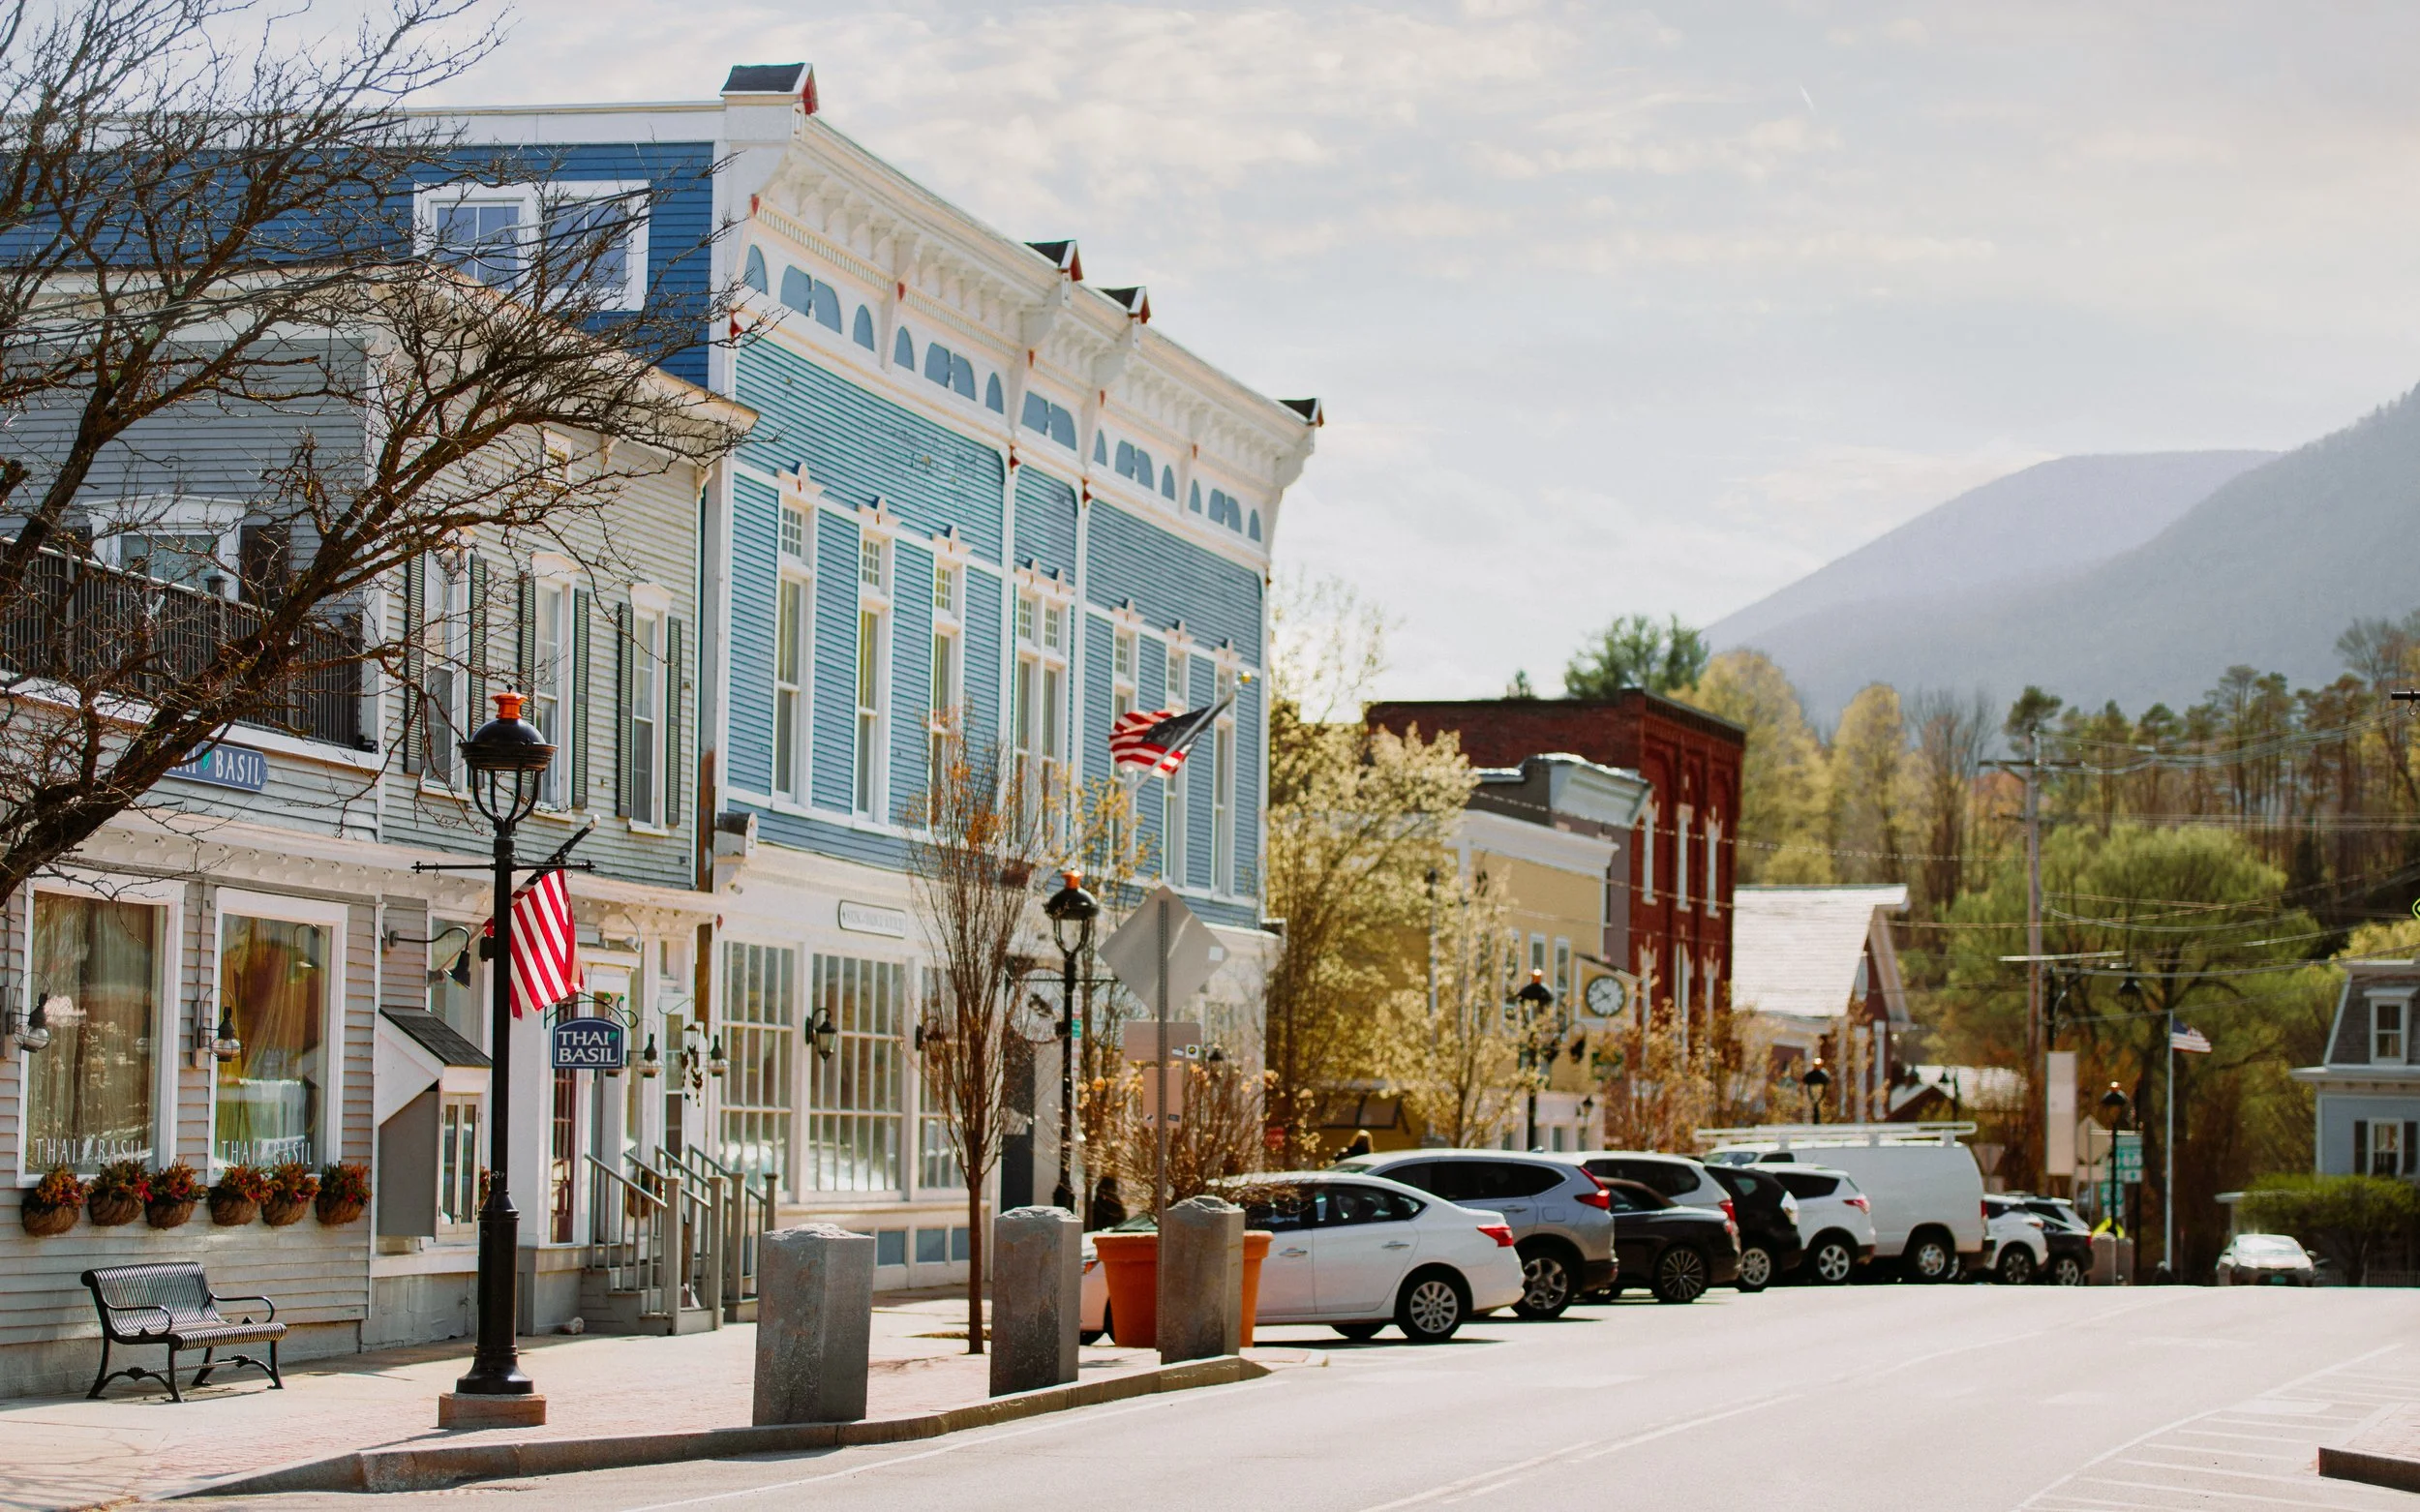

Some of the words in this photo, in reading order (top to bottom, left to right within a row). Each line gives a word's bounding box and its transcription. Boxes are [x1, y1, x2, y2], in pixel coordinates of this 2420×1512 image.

[215, 749, 261, 786] BASIL
[558, 1031, 609, 1045] THAI
[559, 1047, 618, 1063] BASIL
[35, 1138, 76, 1164] THAI
[98, 1138, 142, 1164] BASIL
[221, 1140, 256, 1164] THAI
[274, 1142, 313, 1164] BASIL
